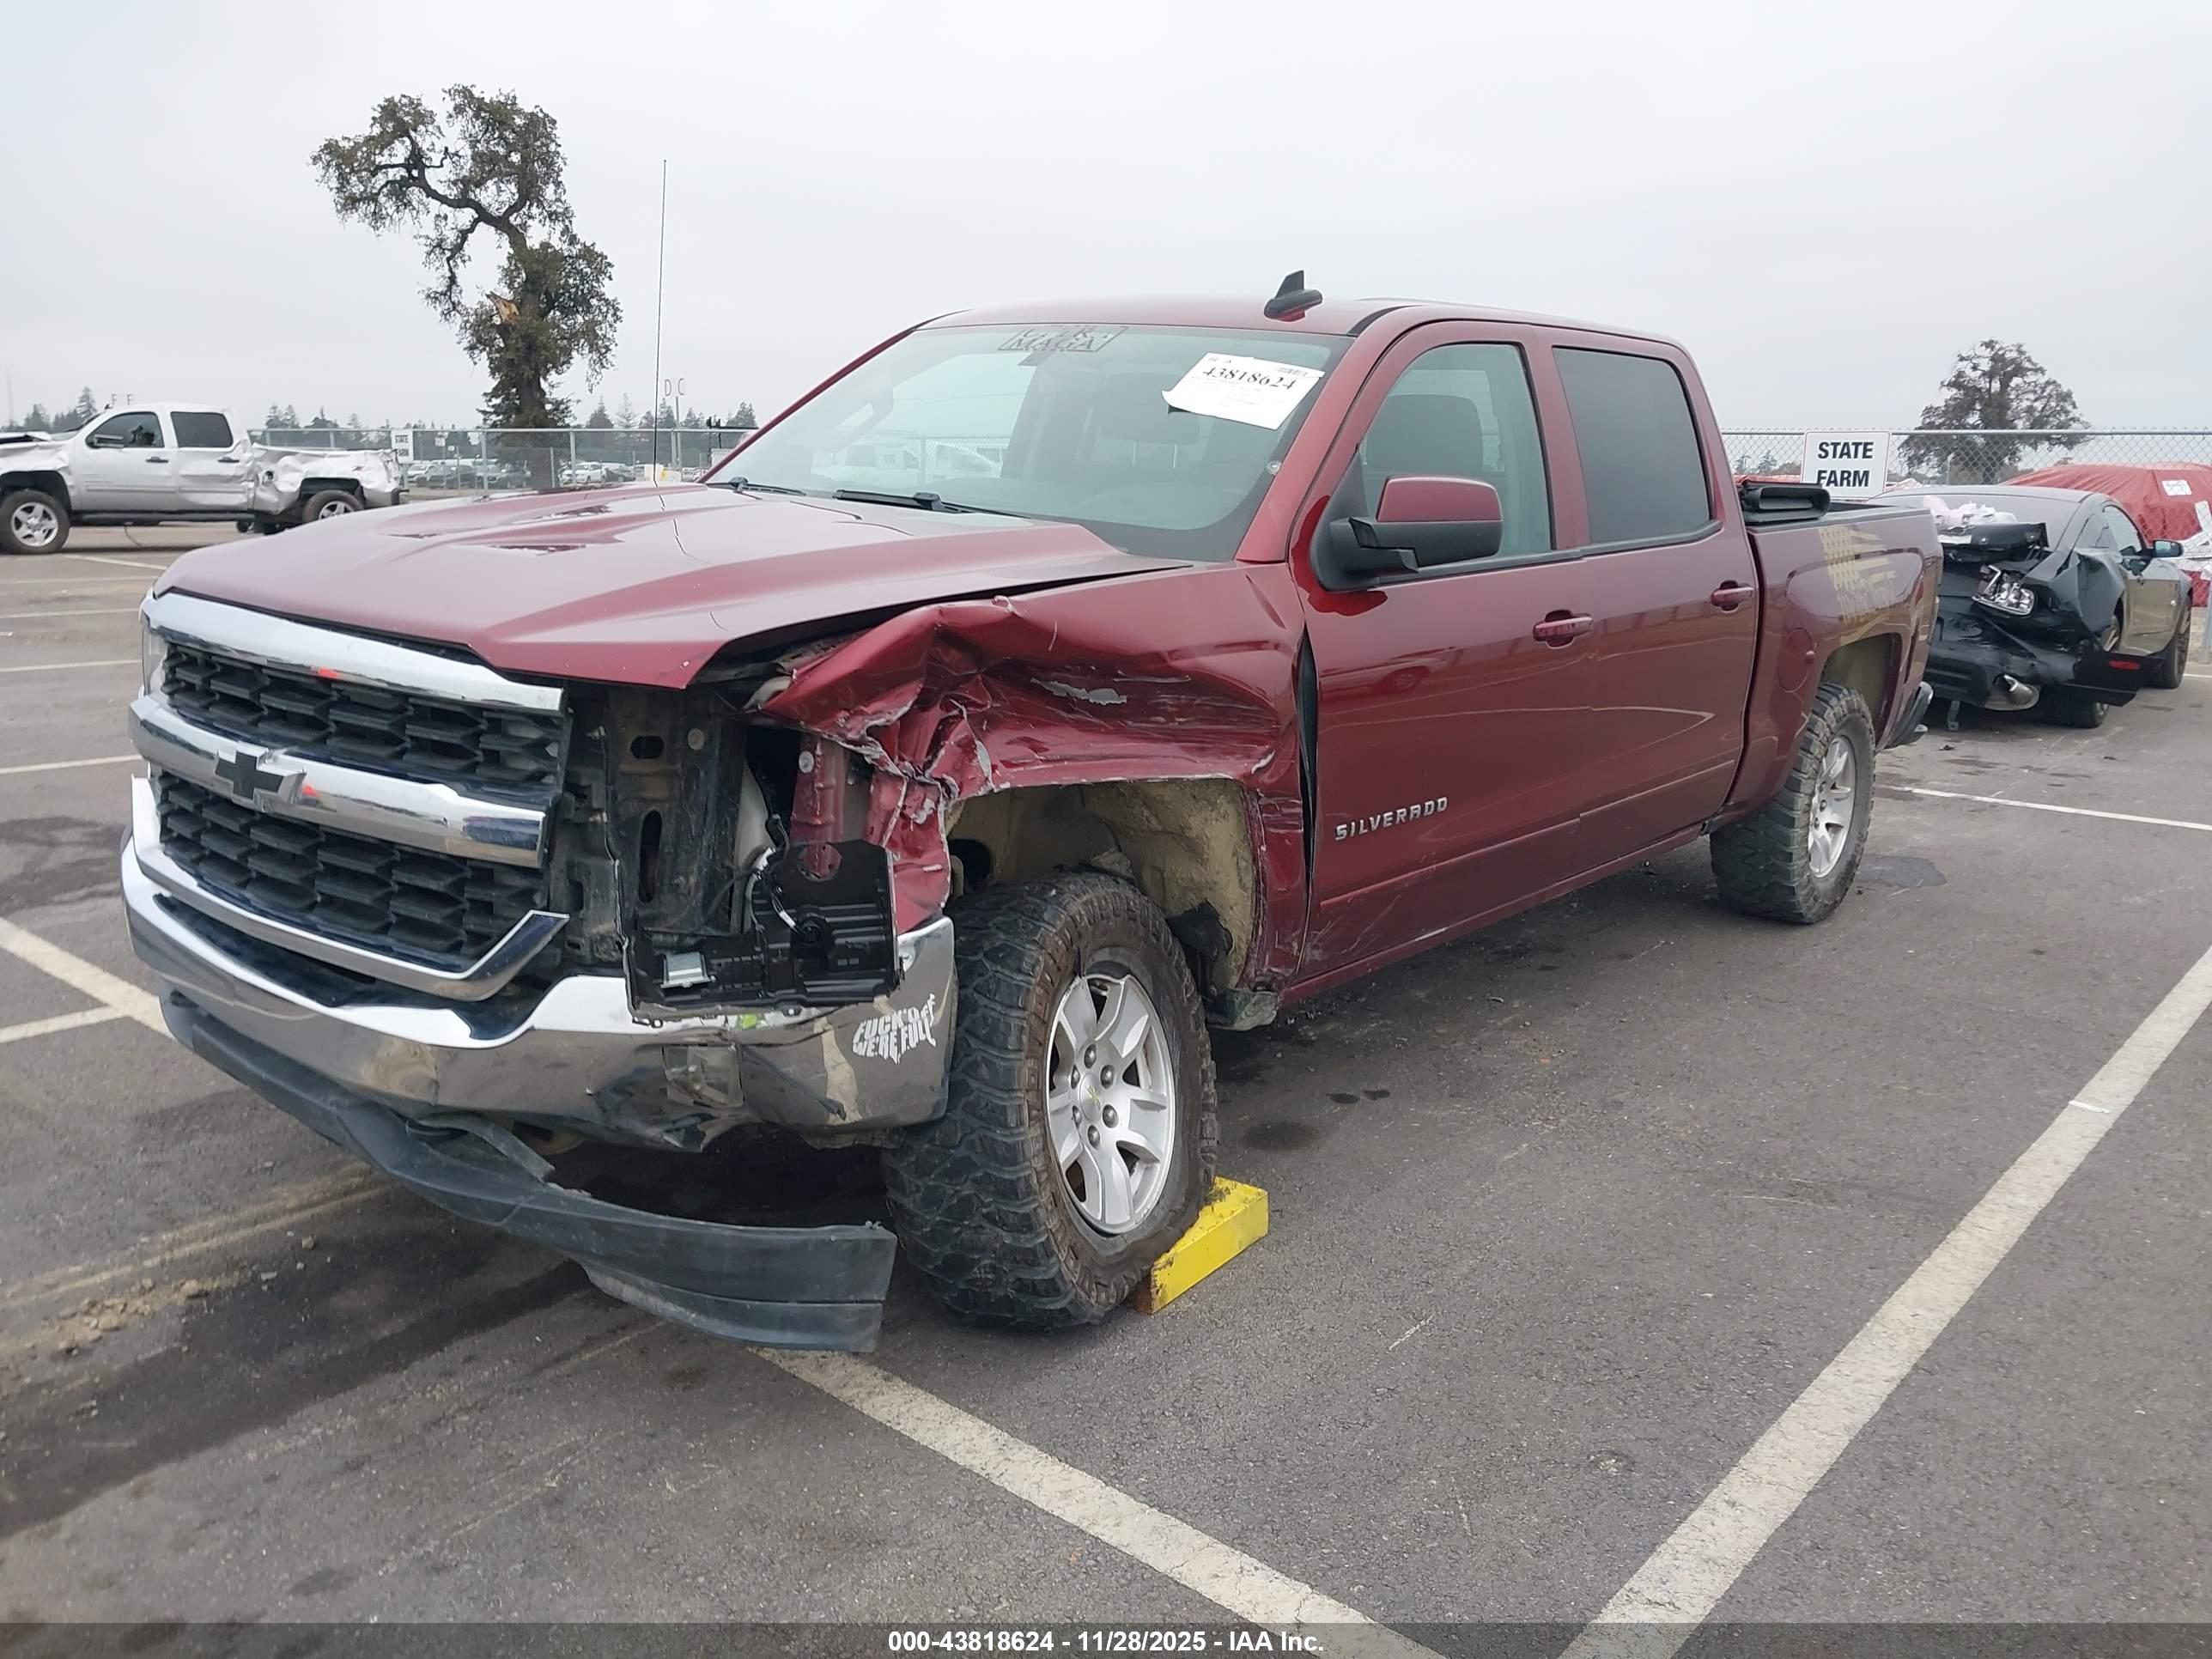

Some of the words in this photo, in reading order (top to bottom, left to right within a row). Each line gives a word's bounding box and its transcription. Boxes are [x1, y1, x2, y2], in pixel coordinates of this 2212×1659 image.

[1006, 337, 1095, 349] MAGA
[1202, 367, 1297, 390] 43818624
[1817, 441, 1874, 459] STATE
[1816, 470, 1869, 488] FARM
[1334, 797, 1449, 841] SILVERADO
